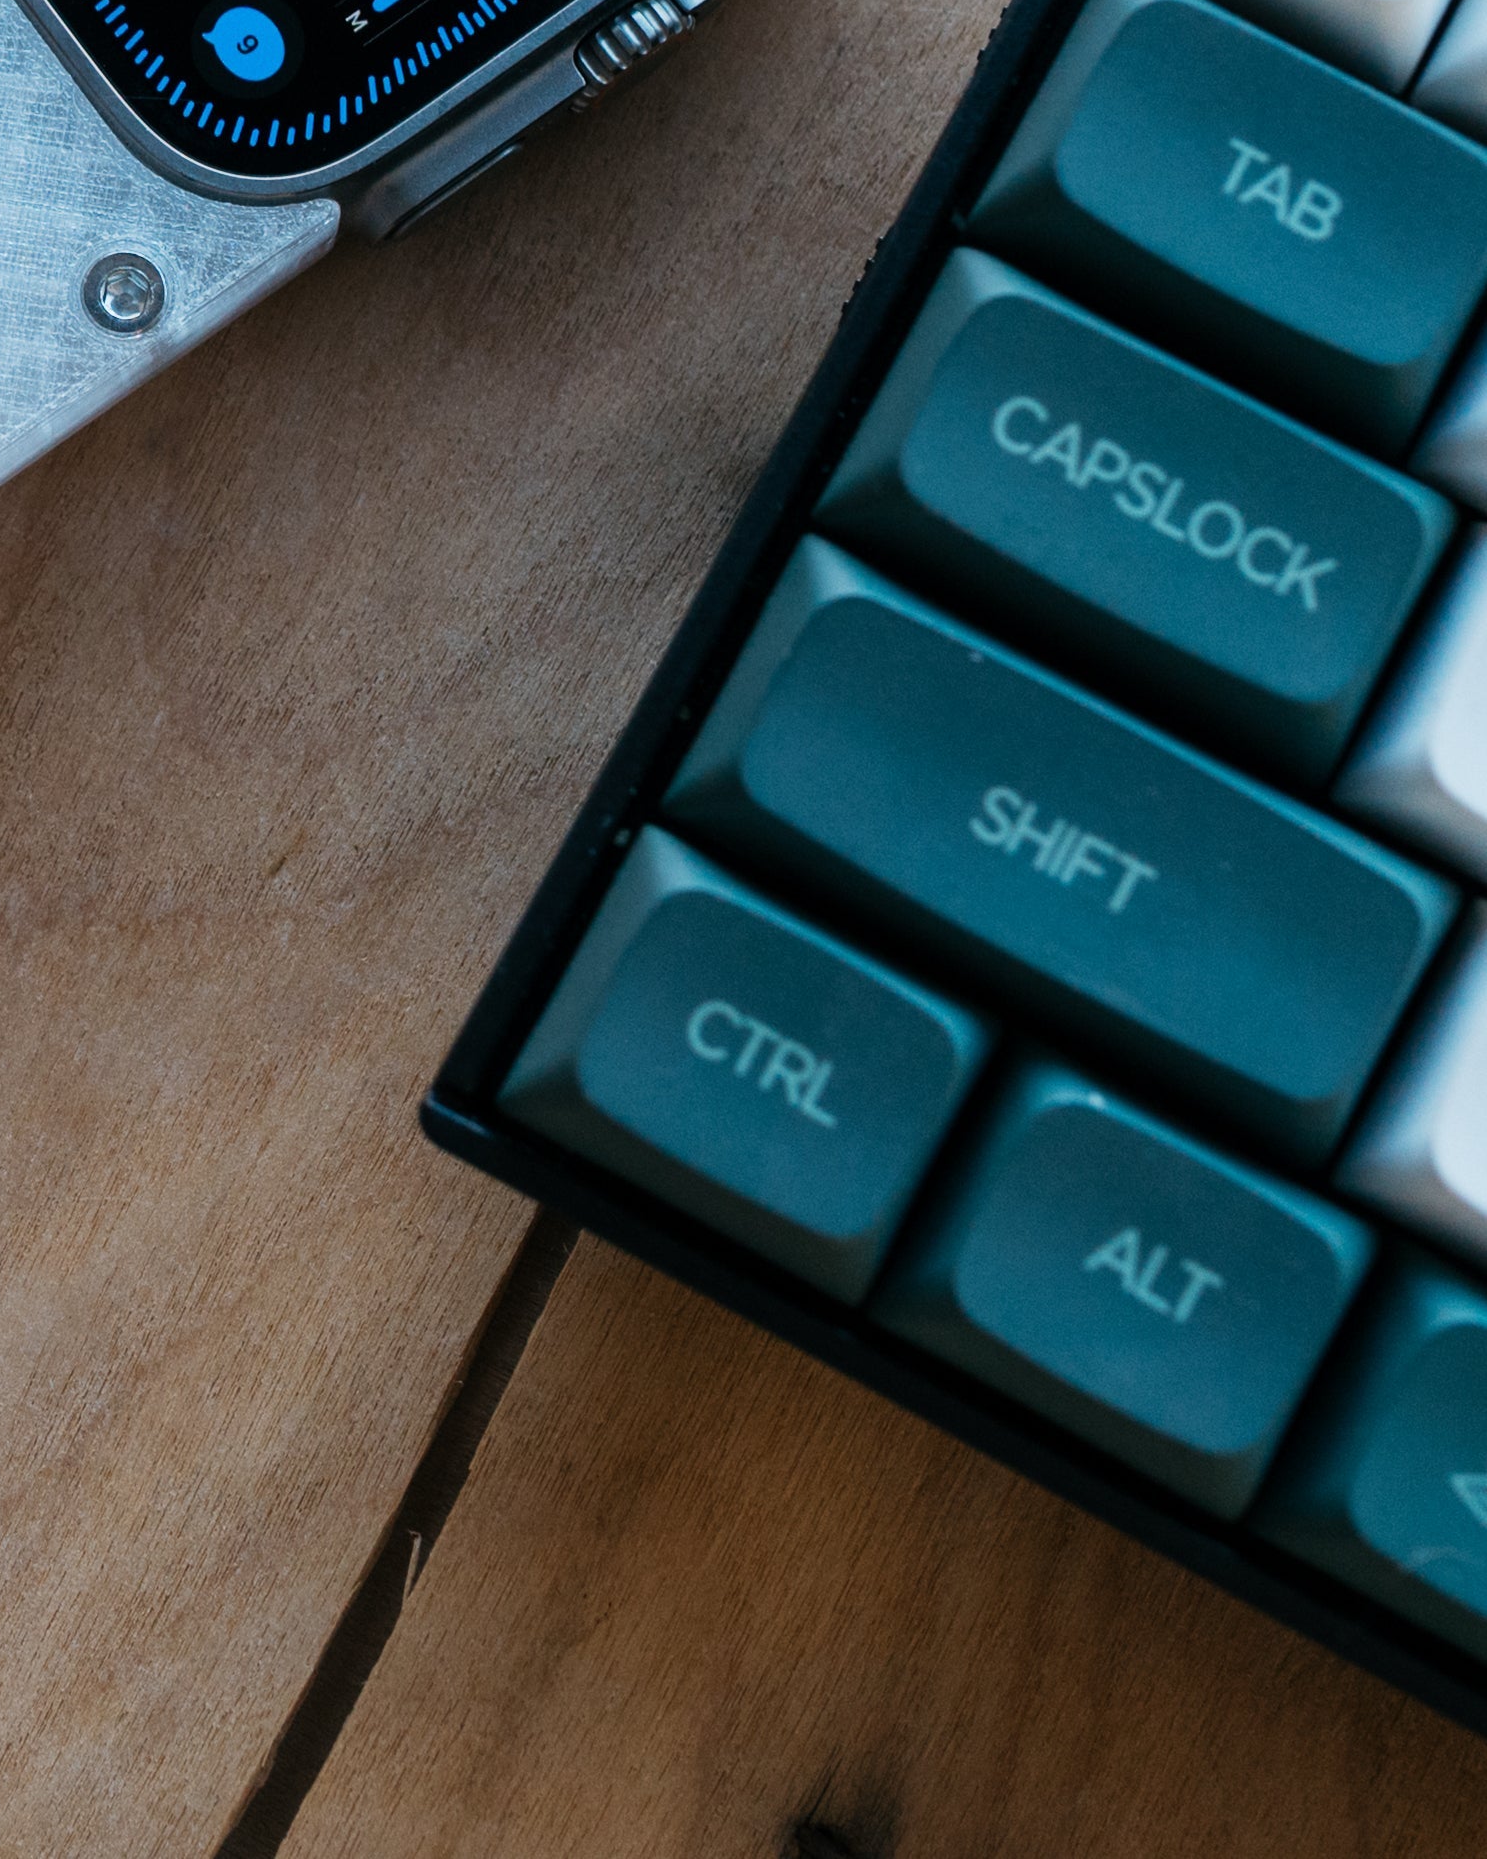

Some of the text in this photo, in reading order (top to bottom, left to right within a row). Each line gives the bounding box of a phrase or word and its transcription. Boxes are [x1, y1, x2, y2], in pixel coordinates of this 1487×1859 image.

[236, 34, 259, 55] 9
[345, 9, 368, 32] M
[1217, 138, 1344, 243] TAB
[991, 396, 1339, 614] CAPSLOCK
[967, 784, 1159, 915] SHIFT
[685, 999, 837, 1130] CTRL
[1083, 1227, 1224, 1324] ALT
